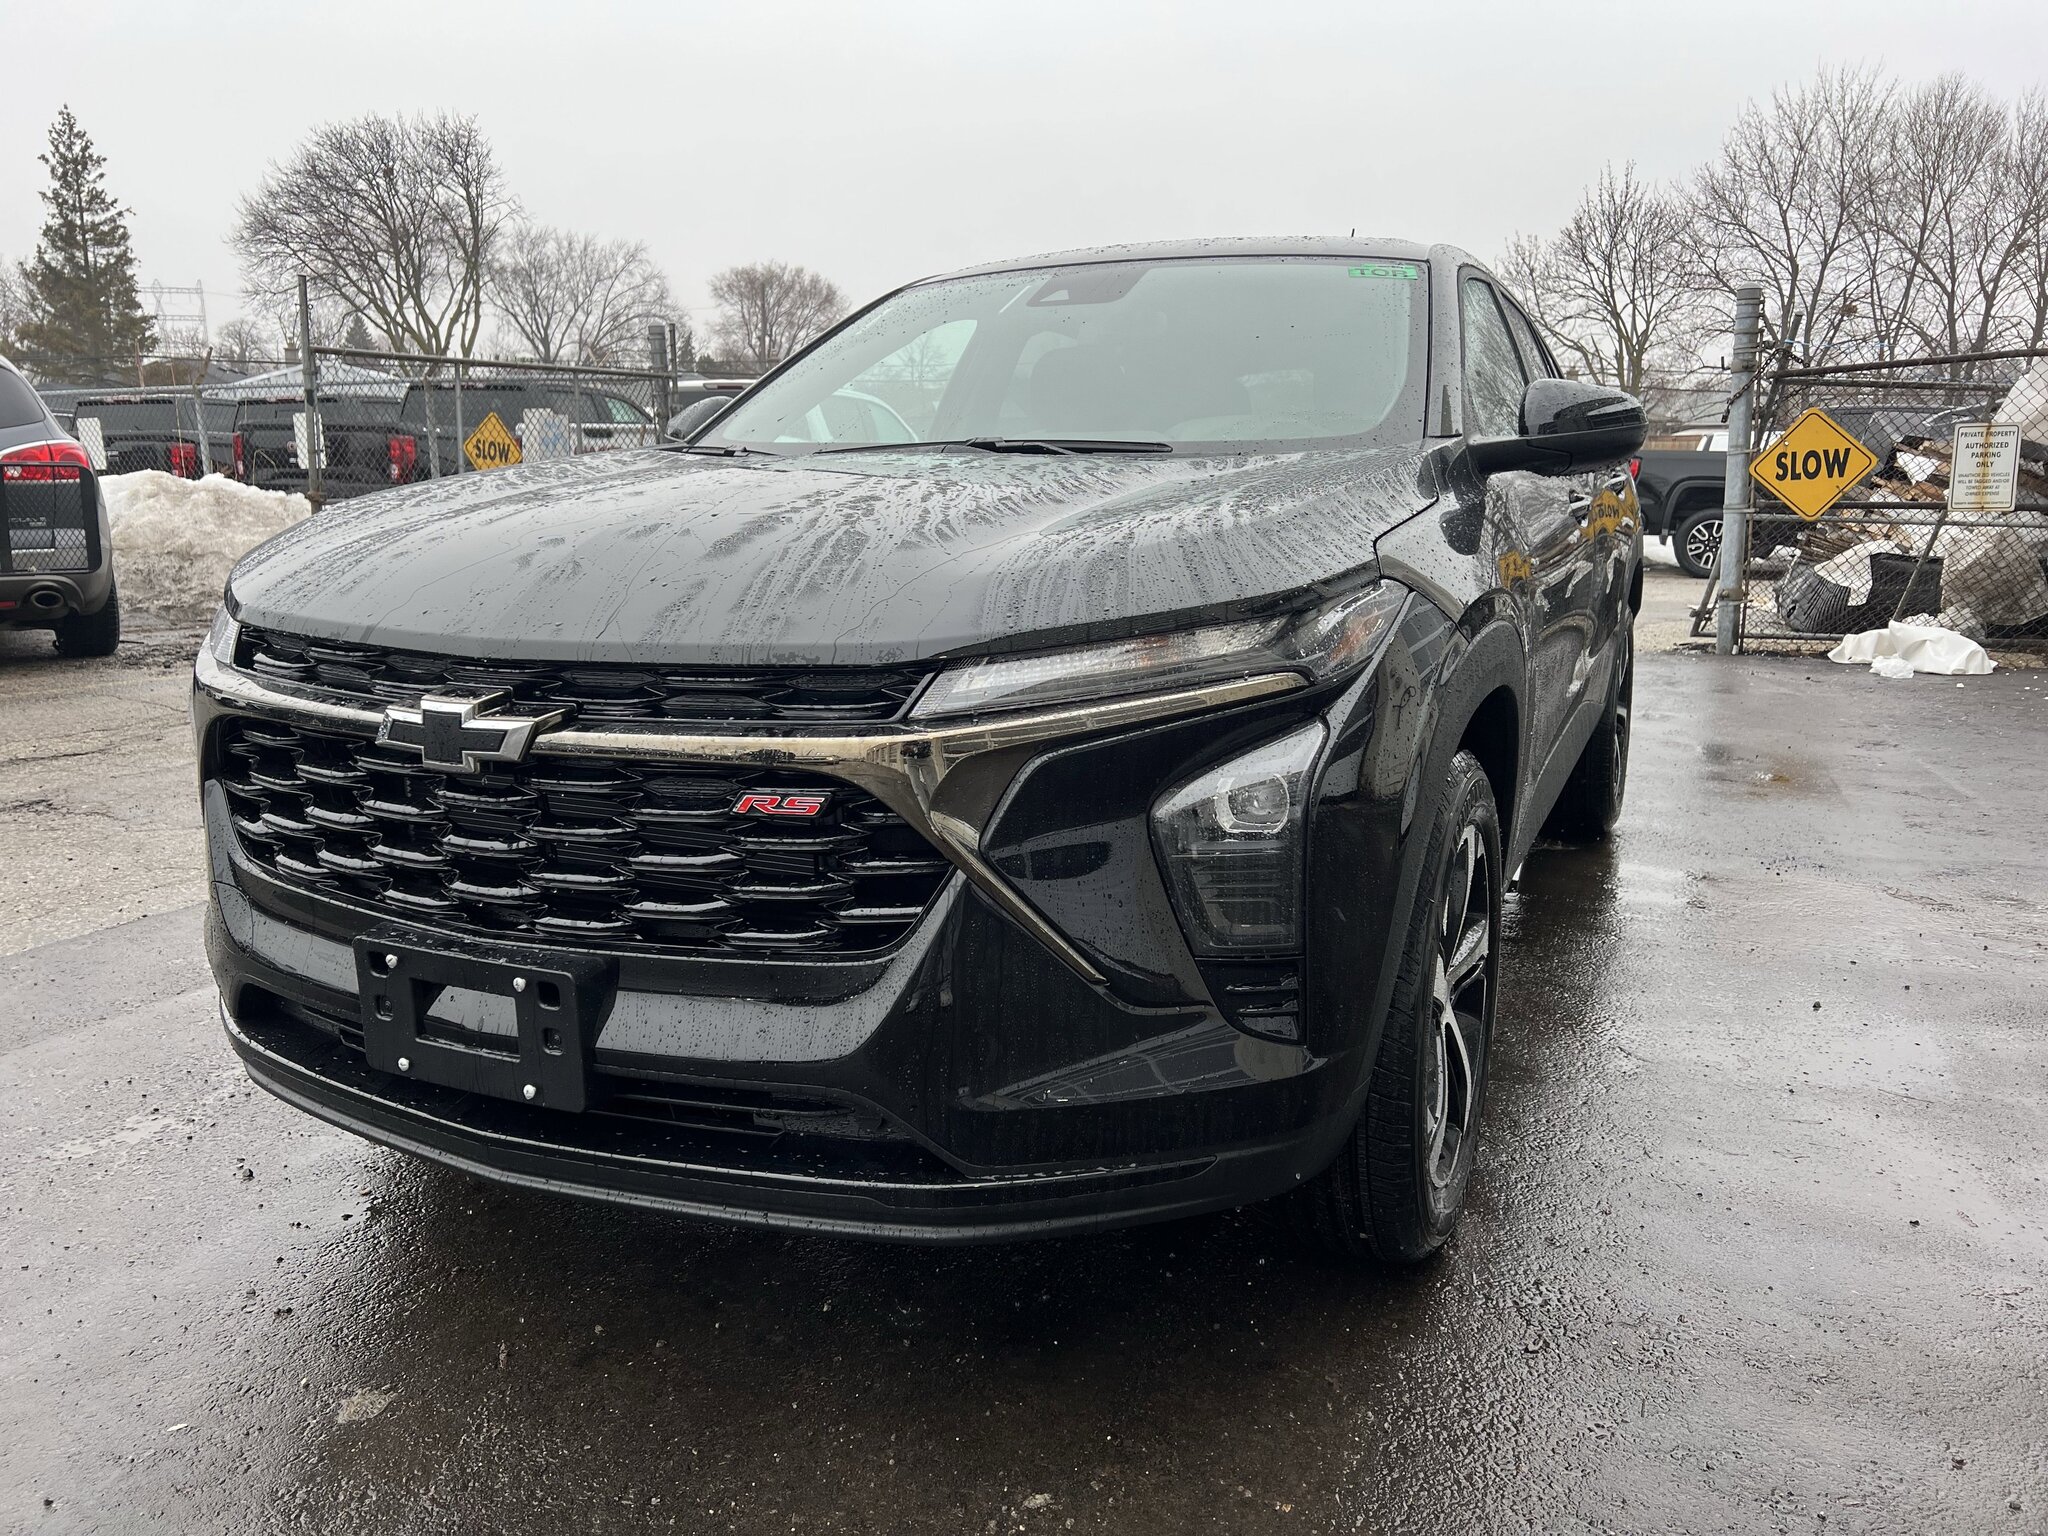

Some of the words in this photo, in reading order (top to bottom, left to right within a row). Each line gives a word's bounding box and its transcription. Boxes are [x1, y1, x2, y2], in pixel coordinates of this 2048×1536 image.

[474, 438, 511, 463] SLOW
[1965, 441, 2009, 449] AUTHORIZED
[1775, 447, 1851, 481] SLOW
[732, 794, 825, 815] RS
